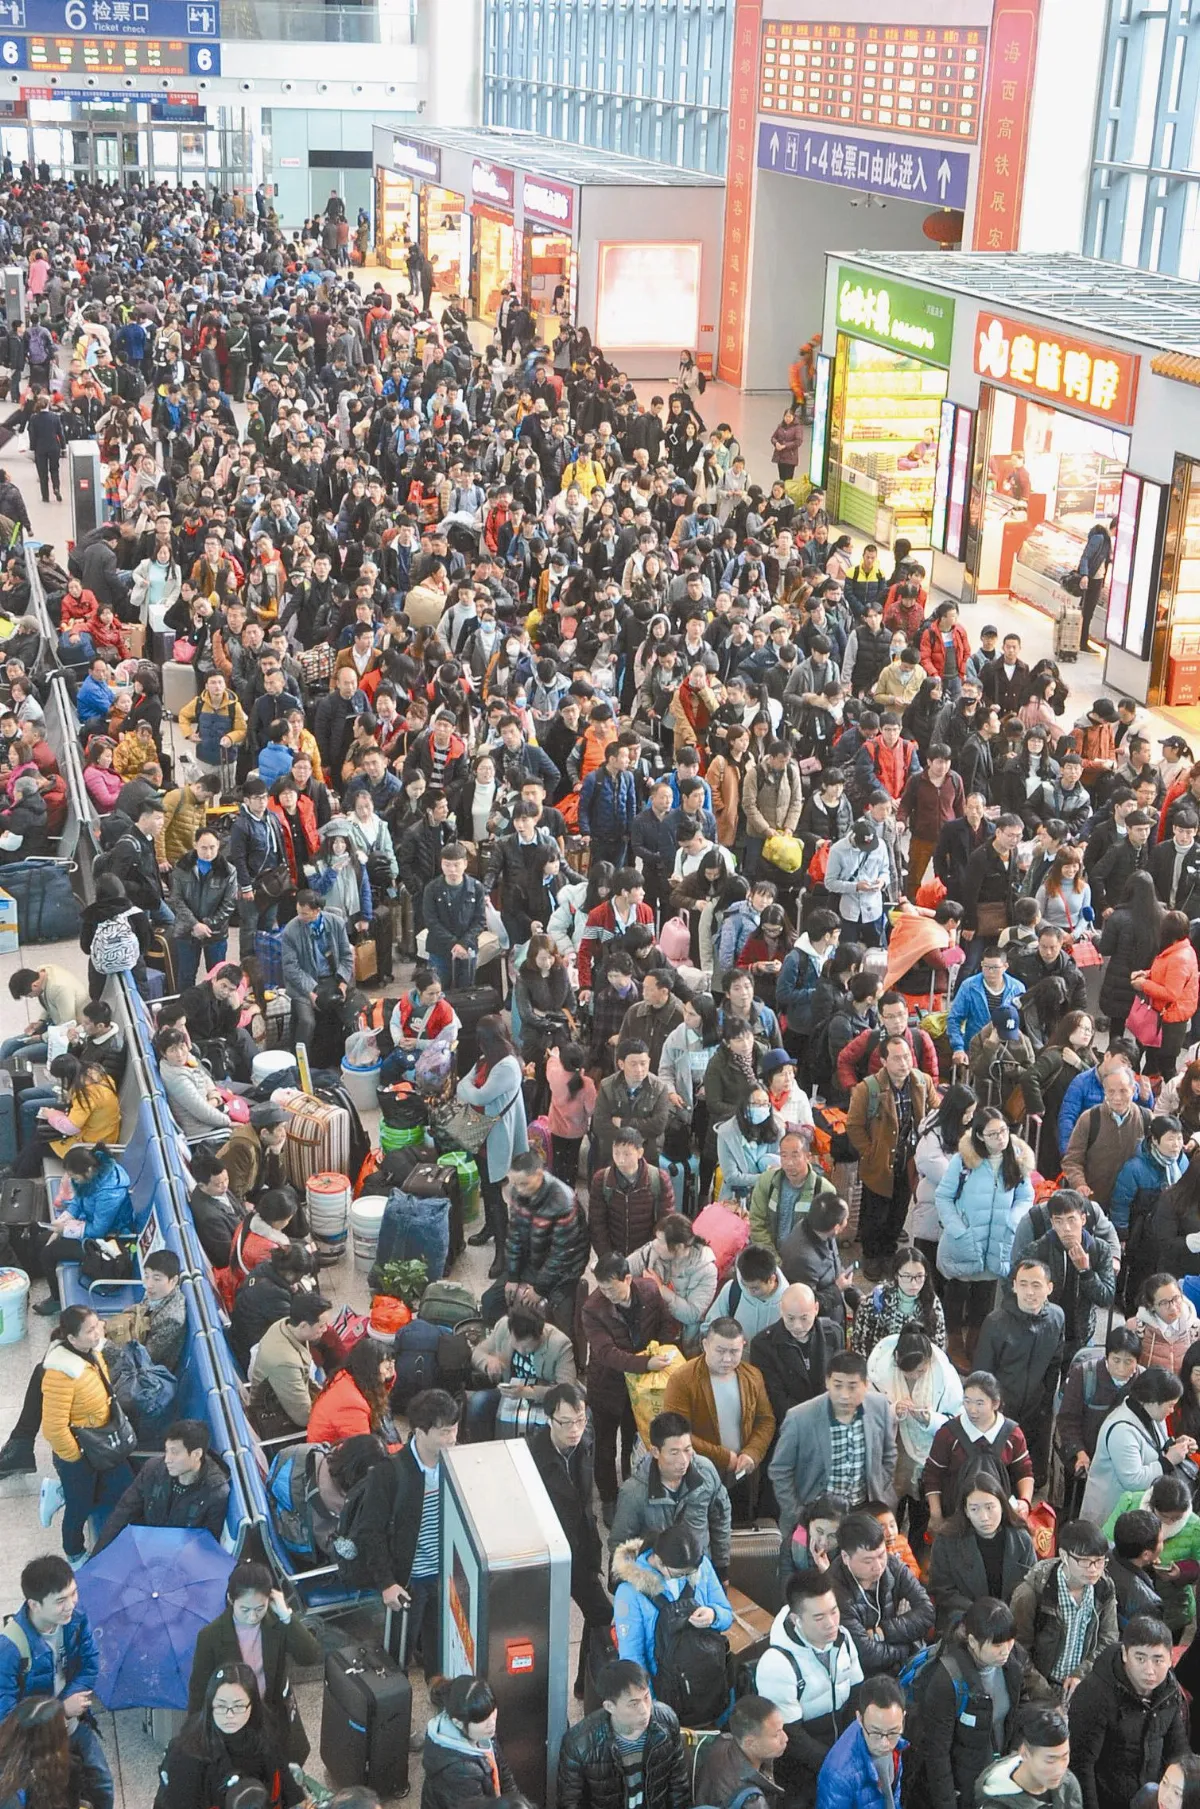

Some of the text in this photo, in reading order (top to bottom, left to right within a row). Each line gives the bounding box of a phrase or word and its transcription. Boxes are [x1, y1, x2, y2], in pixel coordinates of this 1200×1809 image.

[65, 0, 149, 30] 6 检票口
[94, 23, 145, 34] Ticket check
[3, 41, 19, 64] 6
[197, 48, 212, 70] 6
[987, 41, 1021, 248] 海西高铁展宏
